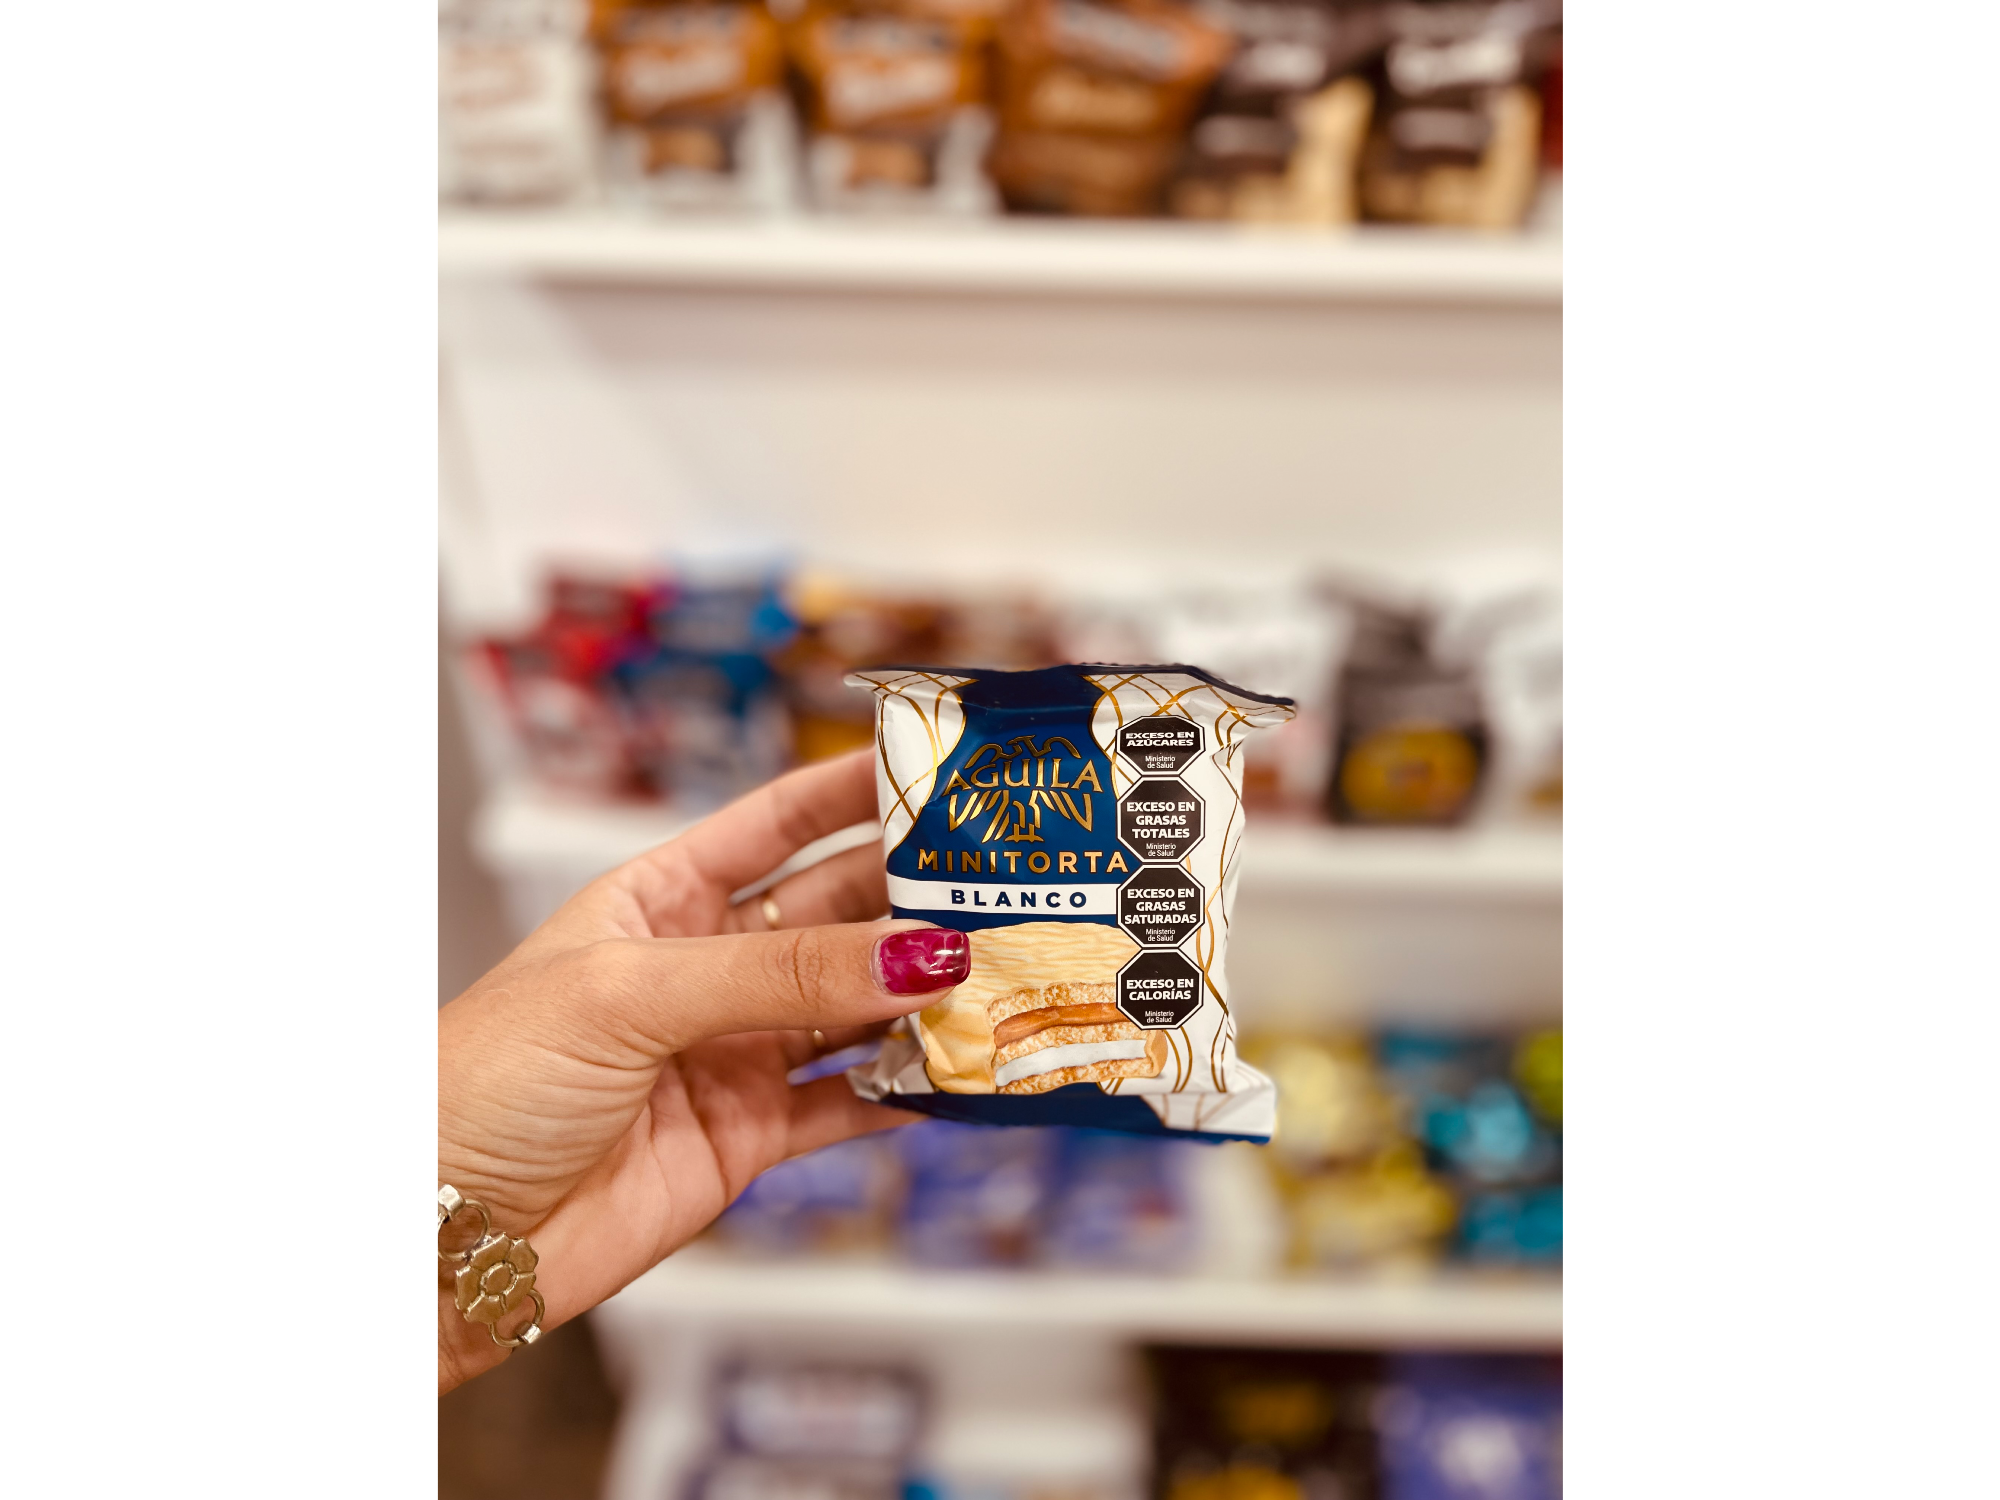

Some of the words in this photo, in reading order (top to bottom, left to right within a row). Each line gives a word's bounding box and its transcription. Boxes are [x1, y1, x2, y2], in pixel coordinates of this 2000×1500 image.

[1177, 731, 1195, 739] EN
[1127, 739, 1194, 747] AZÚCARES
[1126, 802, 1175, 812] EXCESO
[1178, 801, 1195, 812] EN
[1135, 815, 1187, 826] GRASAS
[1131, 828, 1190, 839] TOTALES
[917, 849, 1129, 874] MINITORTA
[951, 889, 1087, 908] BLANCO
[1127, 888, 1175, 898] EXCESO
[1177, 888, 1195, 898] EN
[1135, 901, 1186, 912] GRASAS
[1124, 914, 1197, 924] SATURADAS
[1126, 979, 1174, 989] EXCESO
[1177, 978, 1194, 989] EN
[1129, 988, 1191, 1000] CALORÍAS
[1155, 1016, 1172, 1024] Salud
